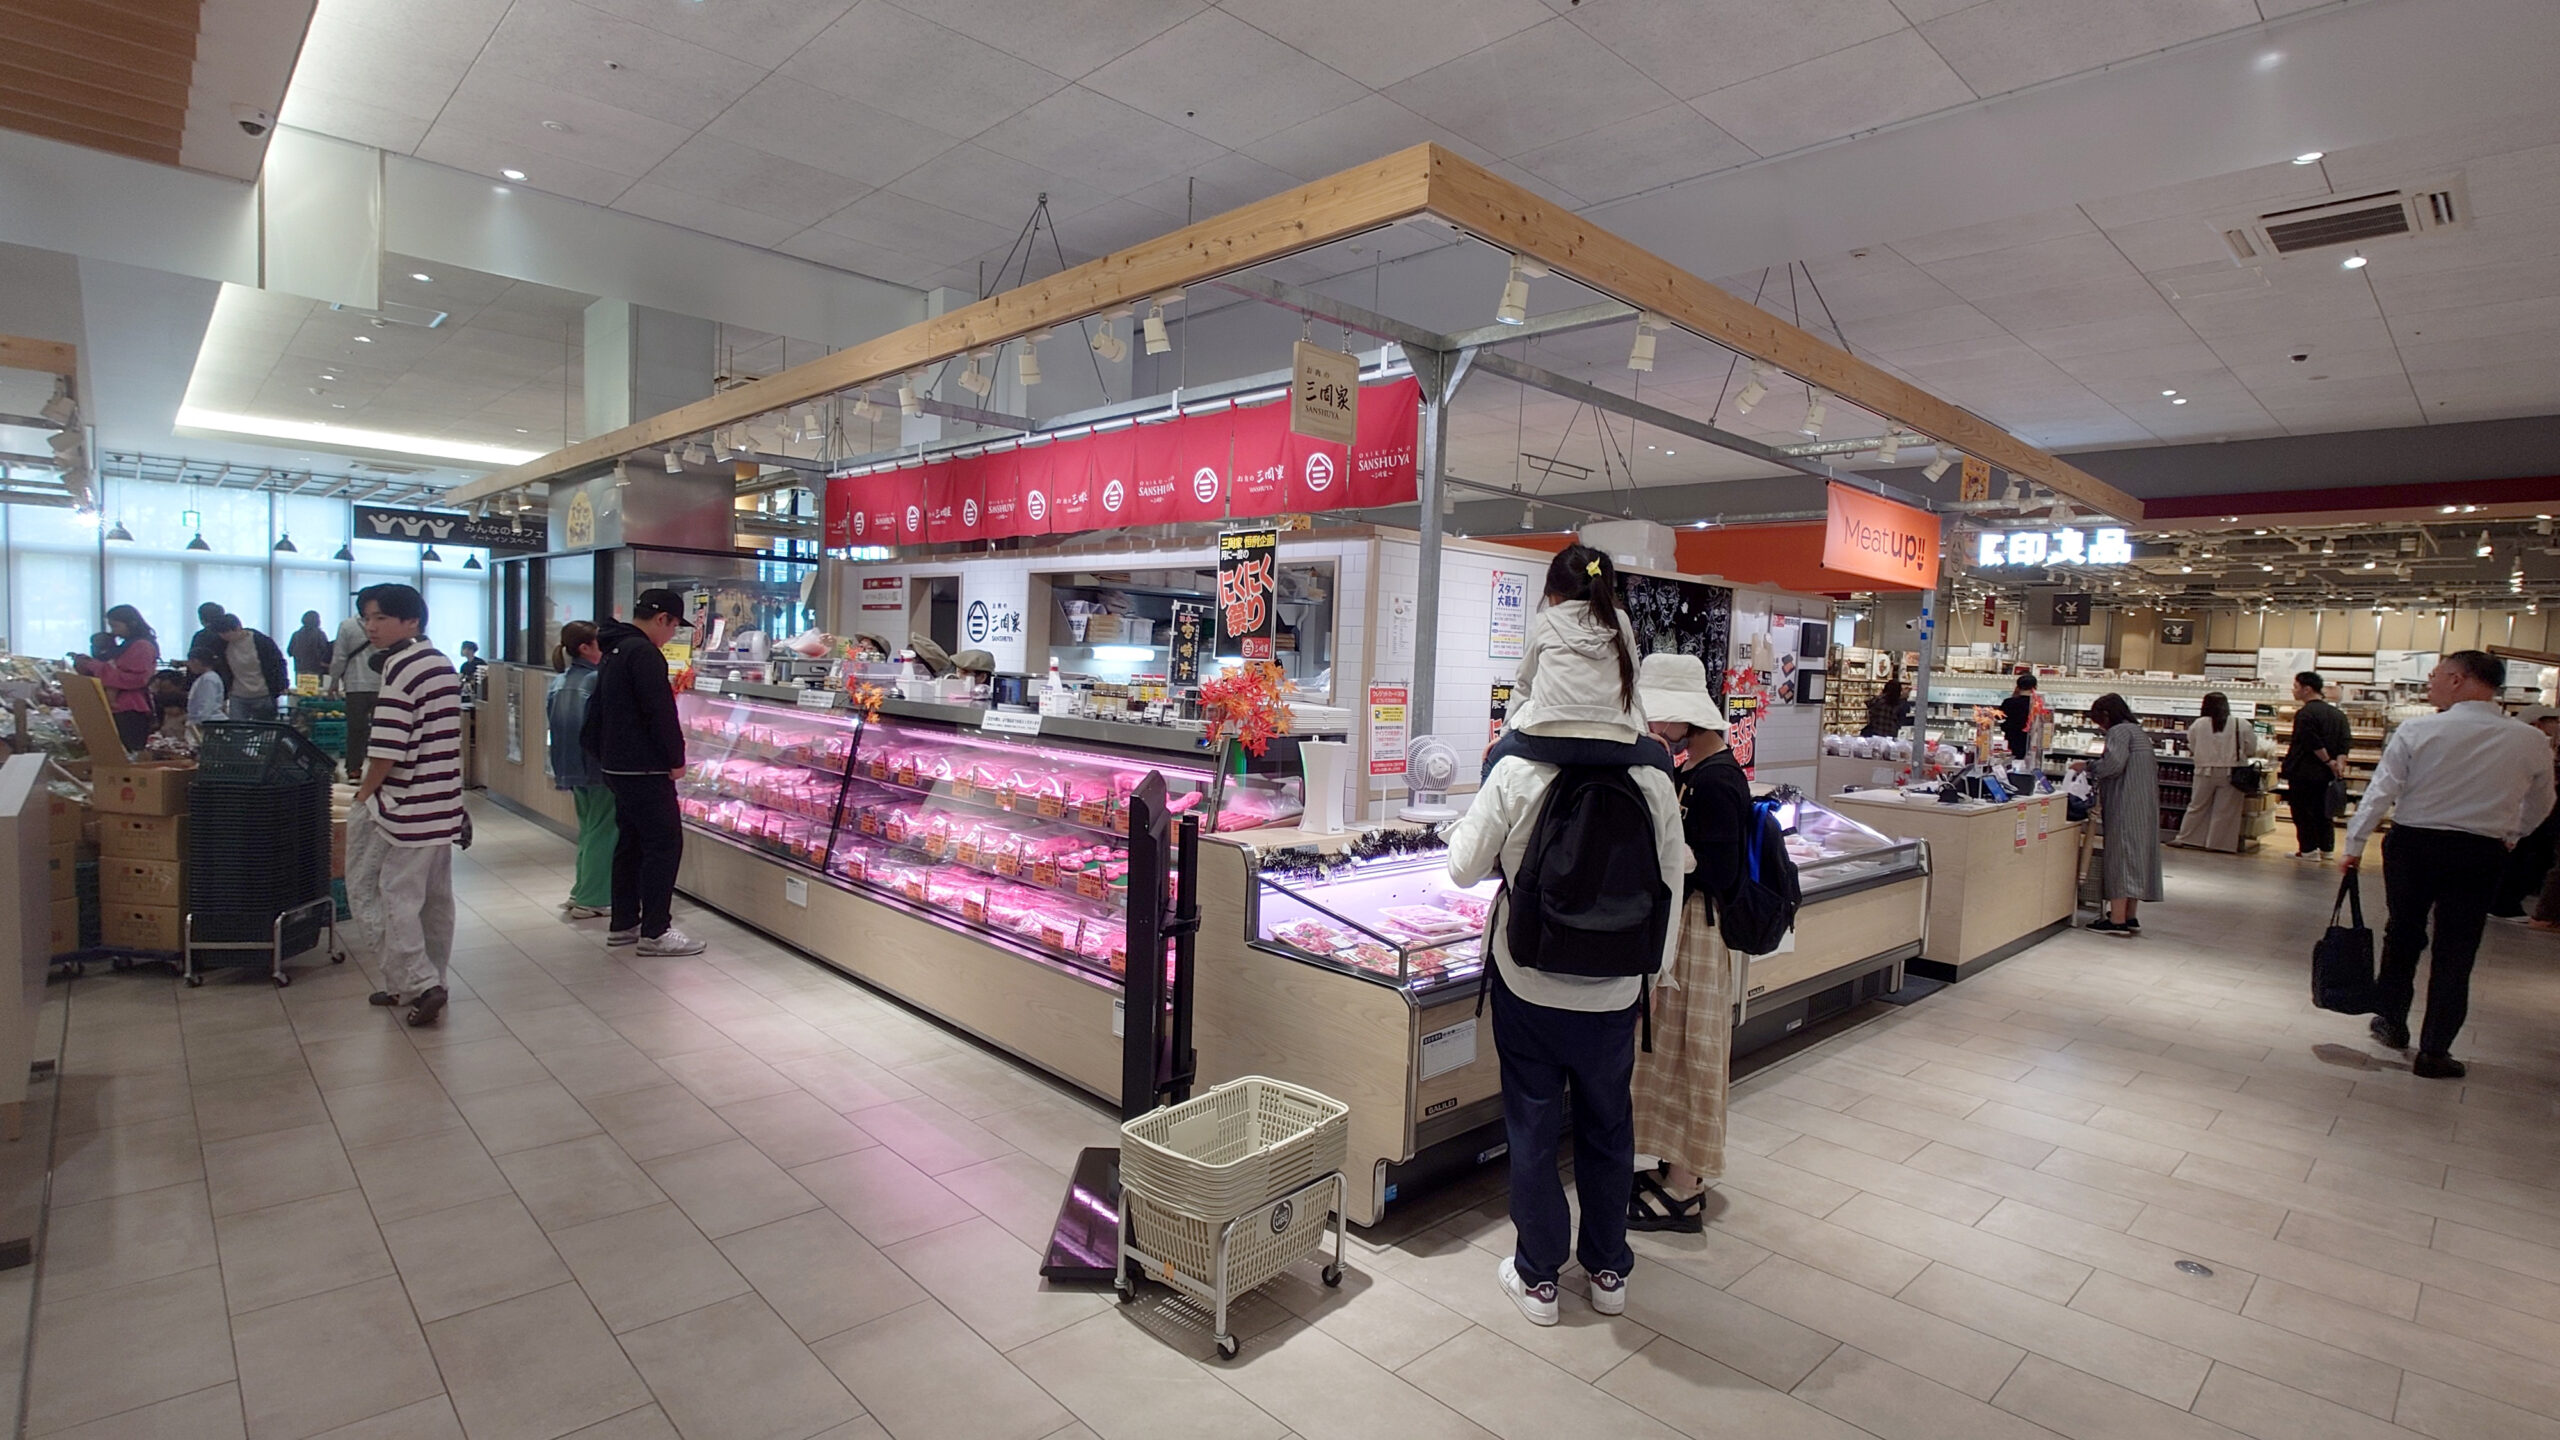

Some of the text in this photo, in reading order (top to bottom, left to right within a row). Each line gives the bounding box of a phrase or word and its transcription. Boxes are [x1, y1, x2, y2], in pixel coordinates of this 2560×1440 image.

[1306, 366, 1330, 379] お肉の
[1305, 405, 1340, 420] SANSHUYA
[1358, 453, 1411, 472] SANSHUYA
[1219, 553, 1275, 609] にくにく
[1498, 584, 1522, 596] スタッフ
[1226, 594, 1266, 638] 祭り
